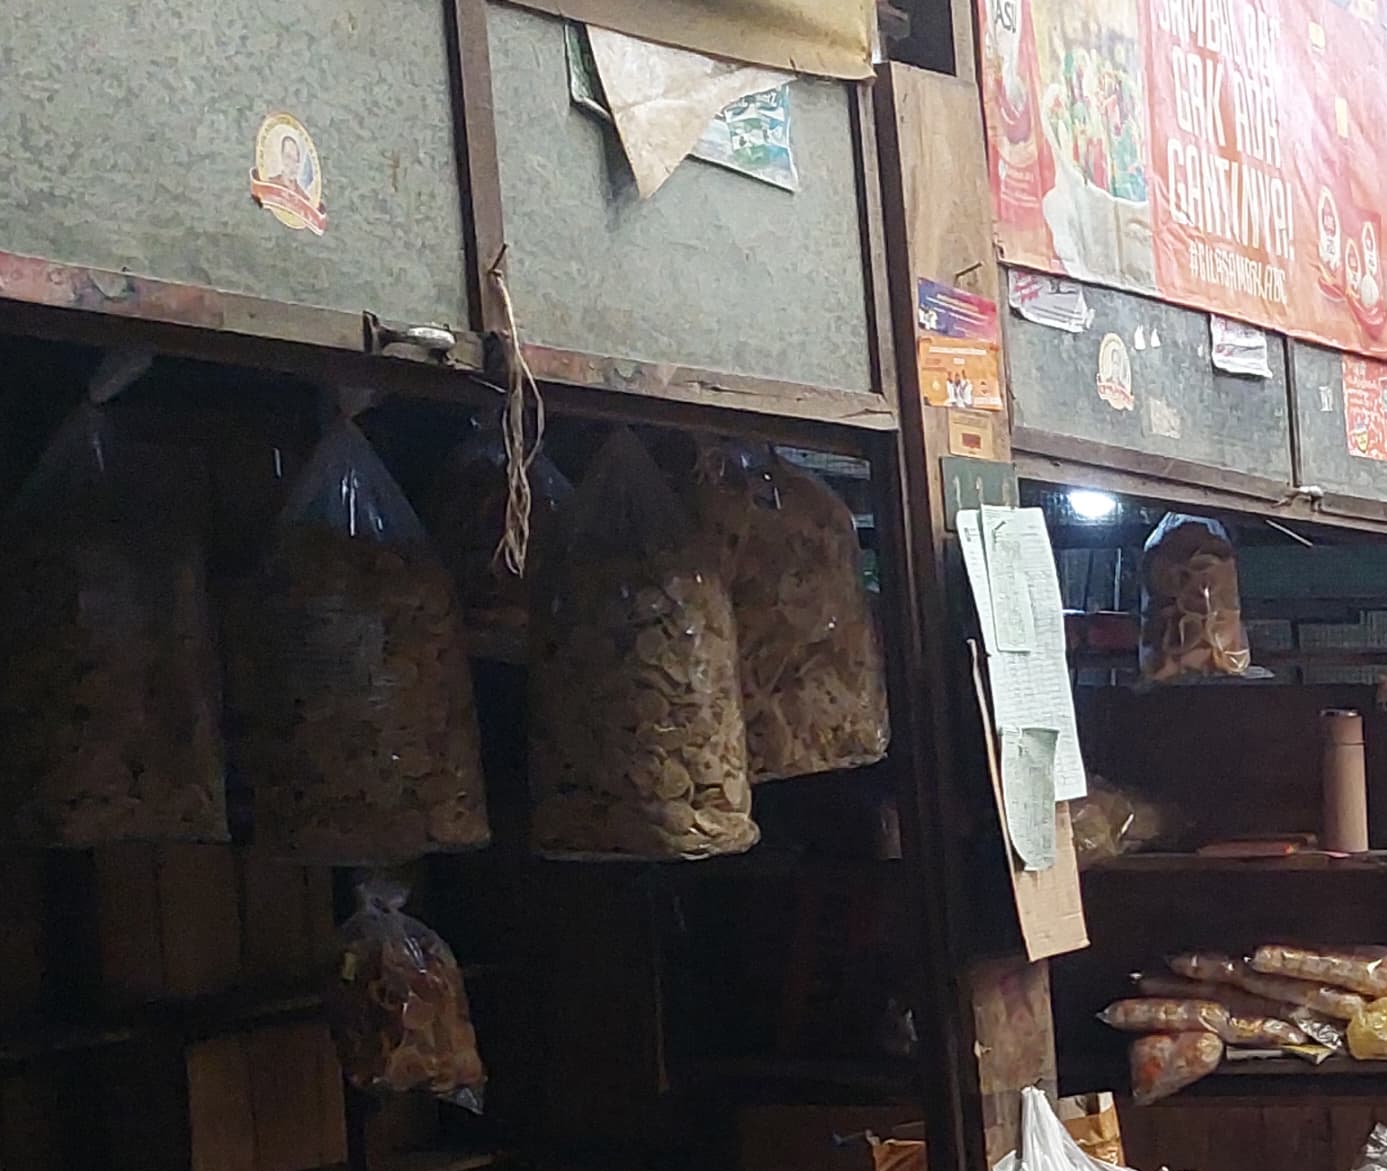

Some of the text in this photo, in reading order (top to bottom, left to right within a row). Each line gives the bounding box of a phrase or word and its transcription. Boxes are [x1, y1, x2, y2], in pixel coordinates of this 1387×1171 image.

[1172, 44, 1281, 168] GAK ADA
[1167, 138, 1295, 262] GANTINYA!
